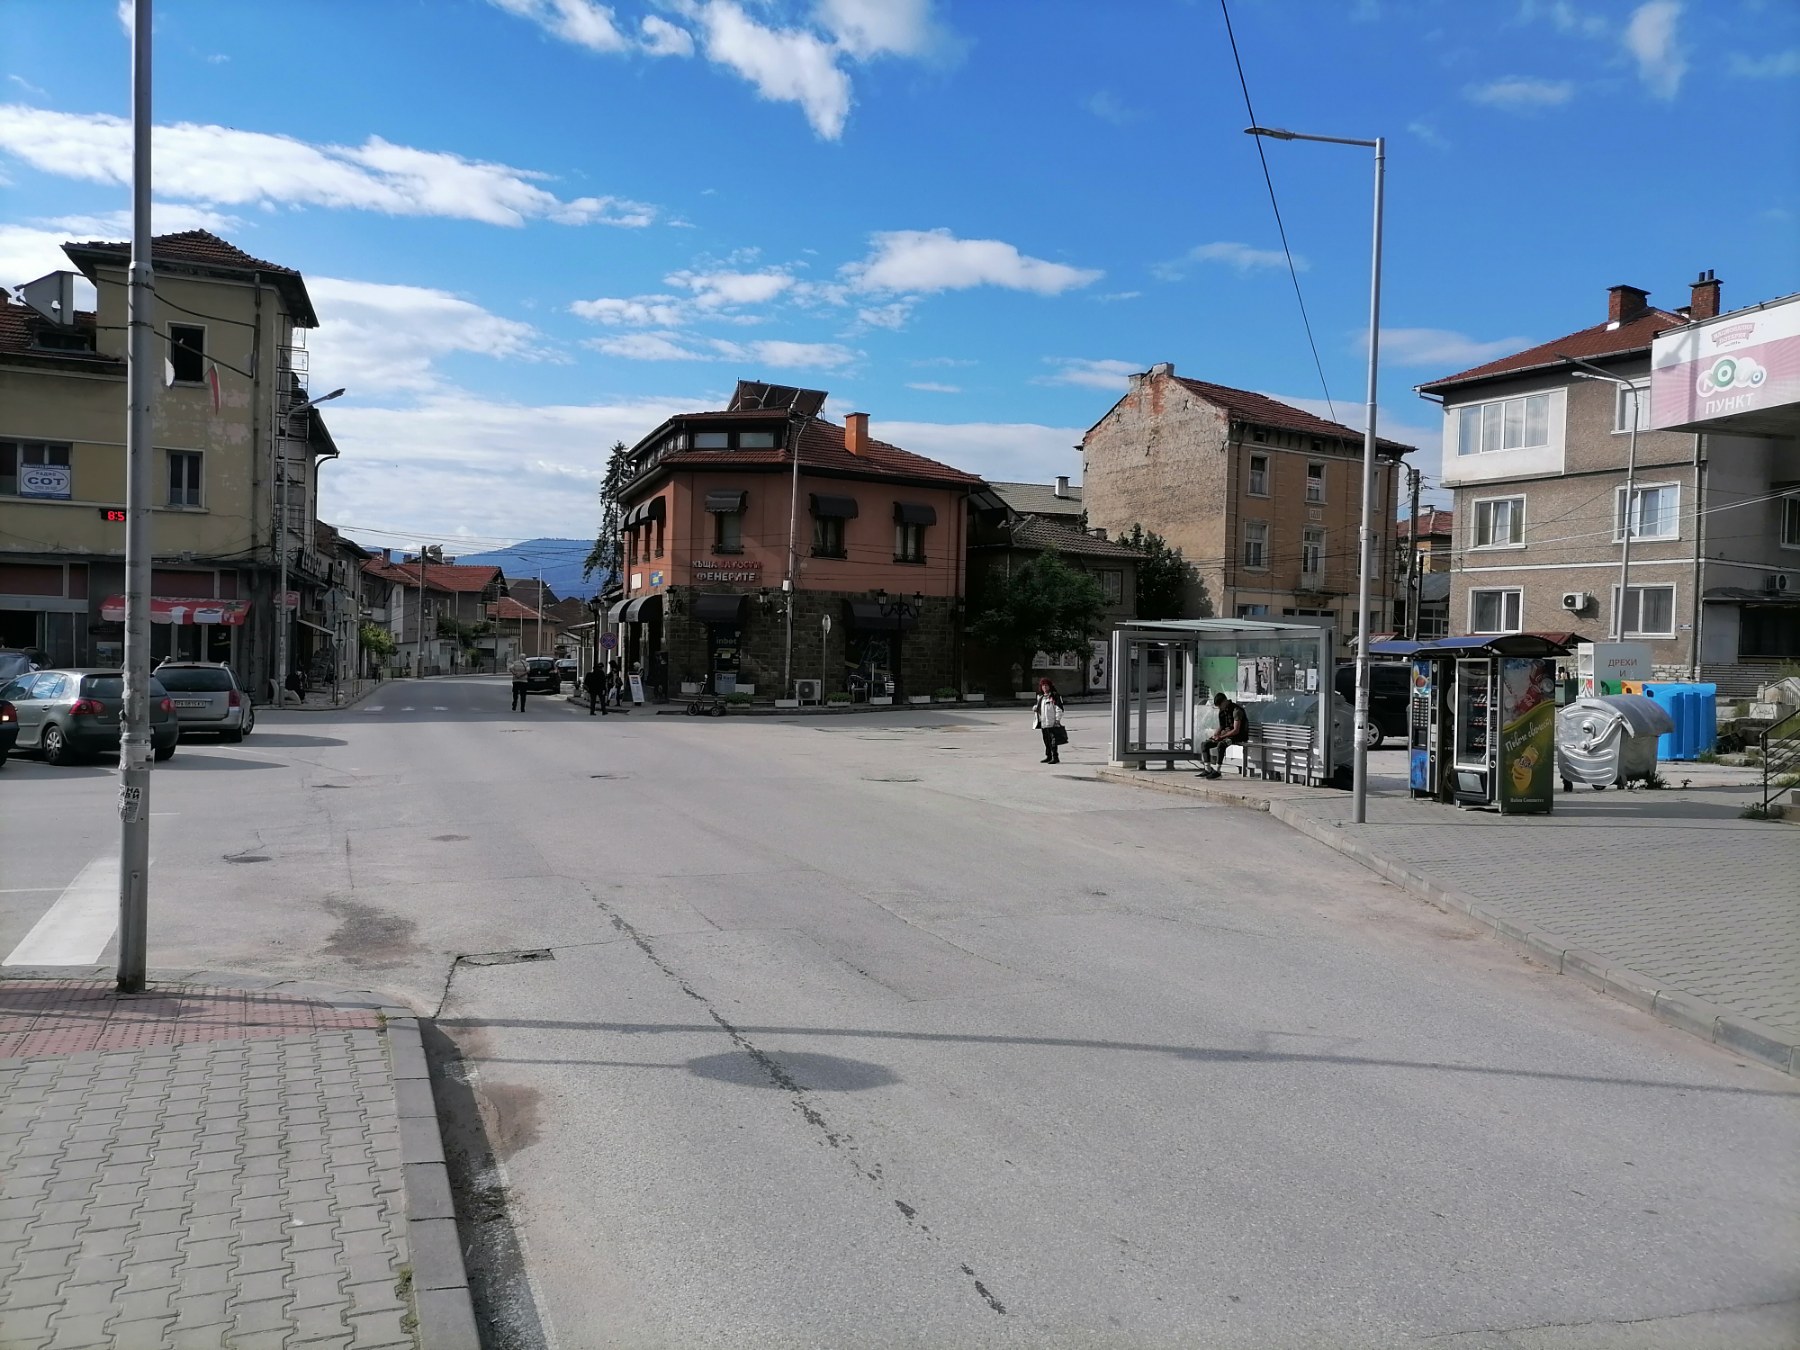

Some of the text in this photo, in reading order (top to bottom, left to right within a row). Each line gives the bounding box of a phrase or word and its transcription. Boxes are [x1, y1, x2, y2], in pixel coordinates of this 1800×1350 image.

[1705, 393, 1754, 414] ПУНКТ
[697, 572, 755, 581] ФЕНЕРИТЕ
[1608, 659, 1638, 667] ДРЕХИ
